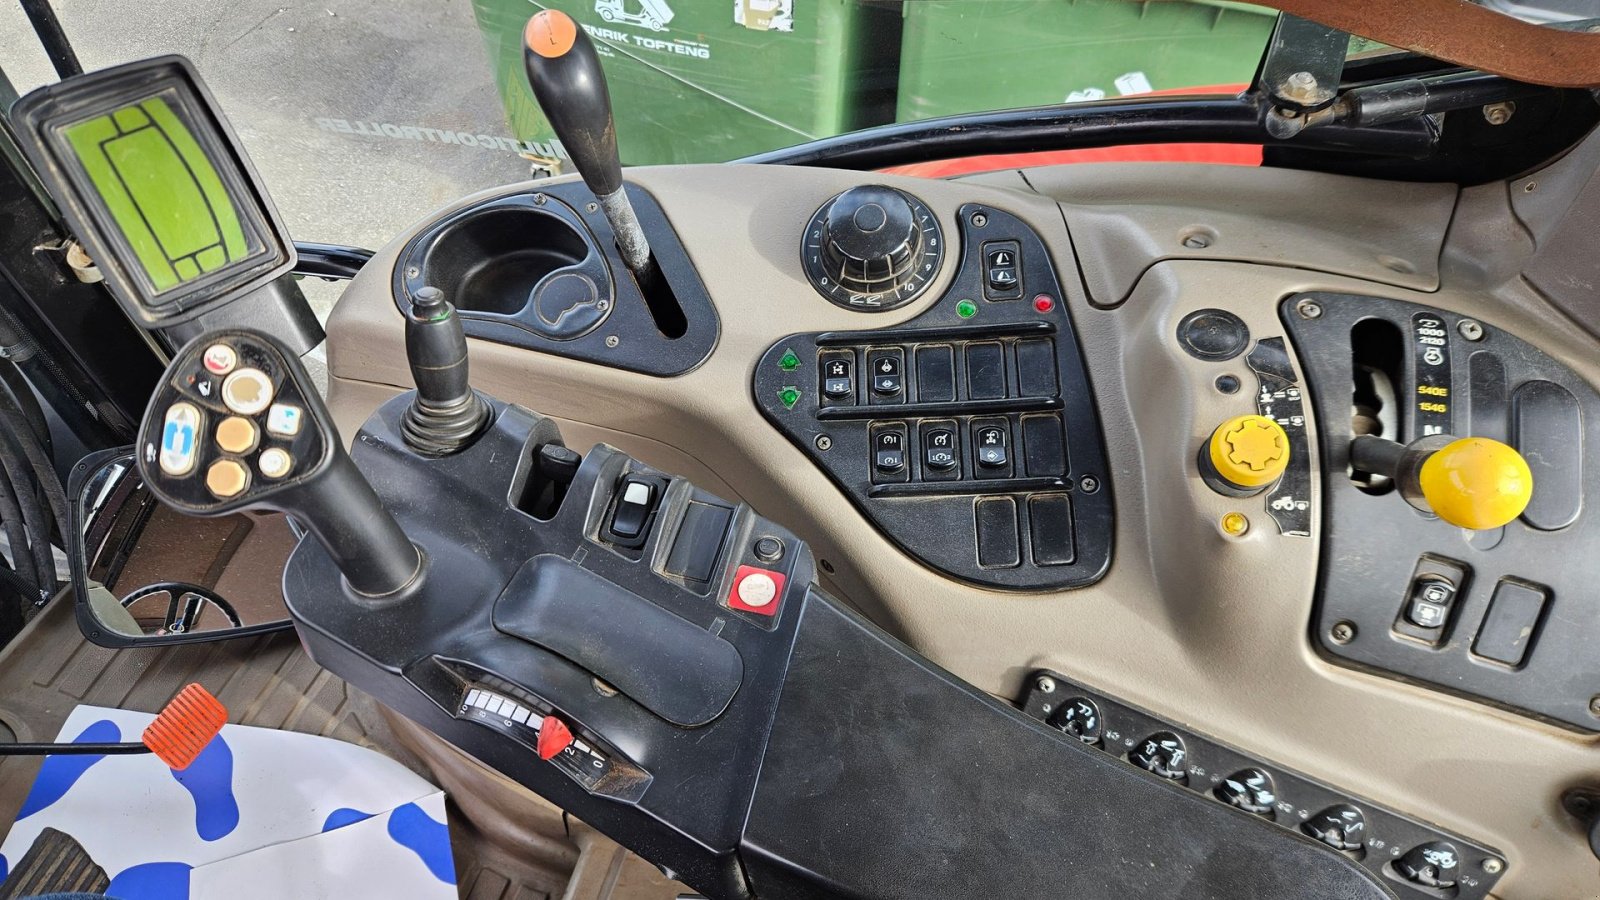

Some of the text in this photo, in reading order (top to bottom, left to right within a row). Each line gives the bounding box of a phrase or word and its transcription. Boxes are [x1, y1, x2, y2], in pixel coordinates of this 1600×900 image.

[632, 35, 710, 59] TOFTENG
[813, 230, 820, 238] 2
[930, 238, 937, 246] 8
[812, 255, 818, 263] 1
[925, 263, 932, 272] 9
[821, 277, 828, 285] 0
[903, 283, 915, 292] 10
[1417, 327, 1446, 337] 1000
[1419, 336, 1446, 346] 2120
[1417, 385, 1448, 397] 540E
[1418, 401, 1447, 413] 1546
[460, 704, 468, 715] 10
[503, 719, 513, 728] 6
[564, 747, 576, 756] 2
[592, 760, 604, 769] 0
